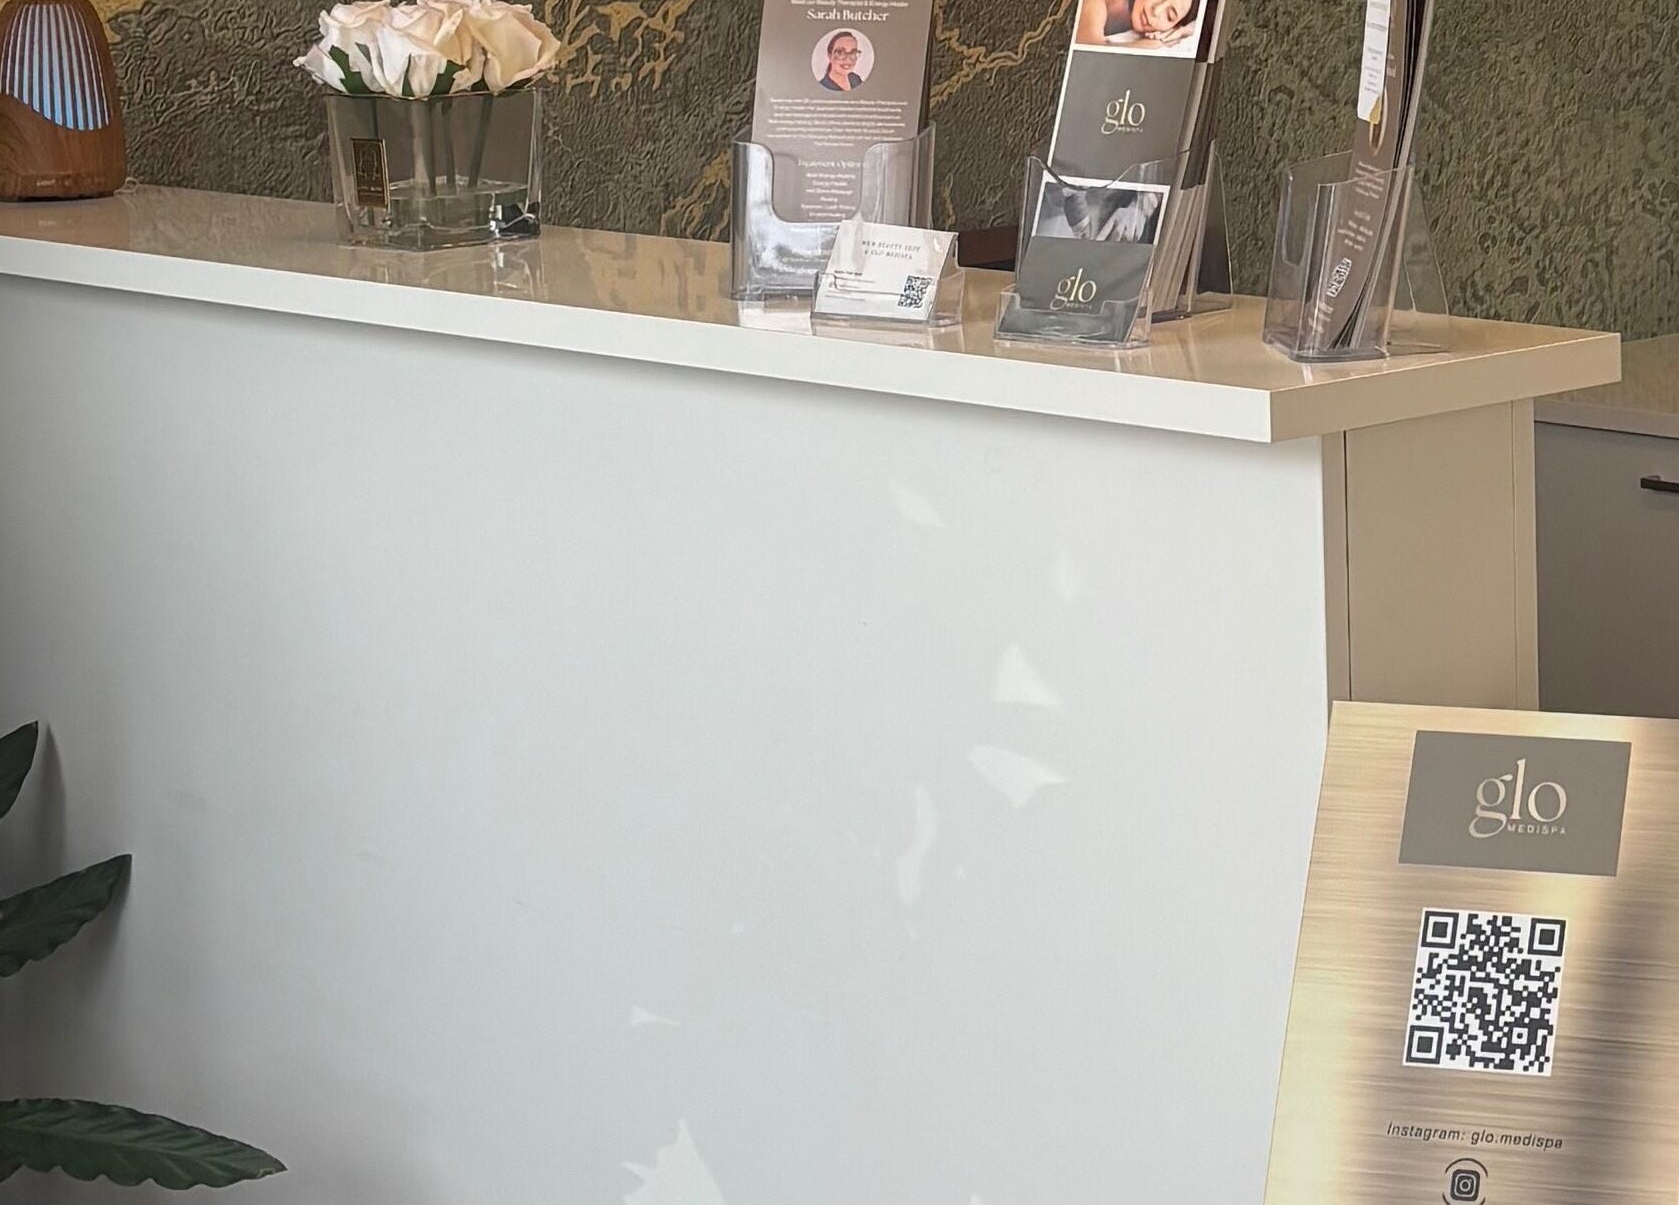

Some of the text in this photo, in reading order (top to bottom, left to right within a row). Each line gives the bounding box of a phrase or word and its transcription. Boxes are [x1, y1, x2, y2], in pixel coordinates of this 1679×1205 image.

[806, 8, 840, 20] Sarah
[1101, 89, 1145, 135] glo
[1050, 267, 1097, 311] glo
[1469, 758, 1567, 838] glo
[1507, 823, 1566, 835] MEDISPA
[1387, 1120, 1563, 1152] Instagram: glo.medispa
